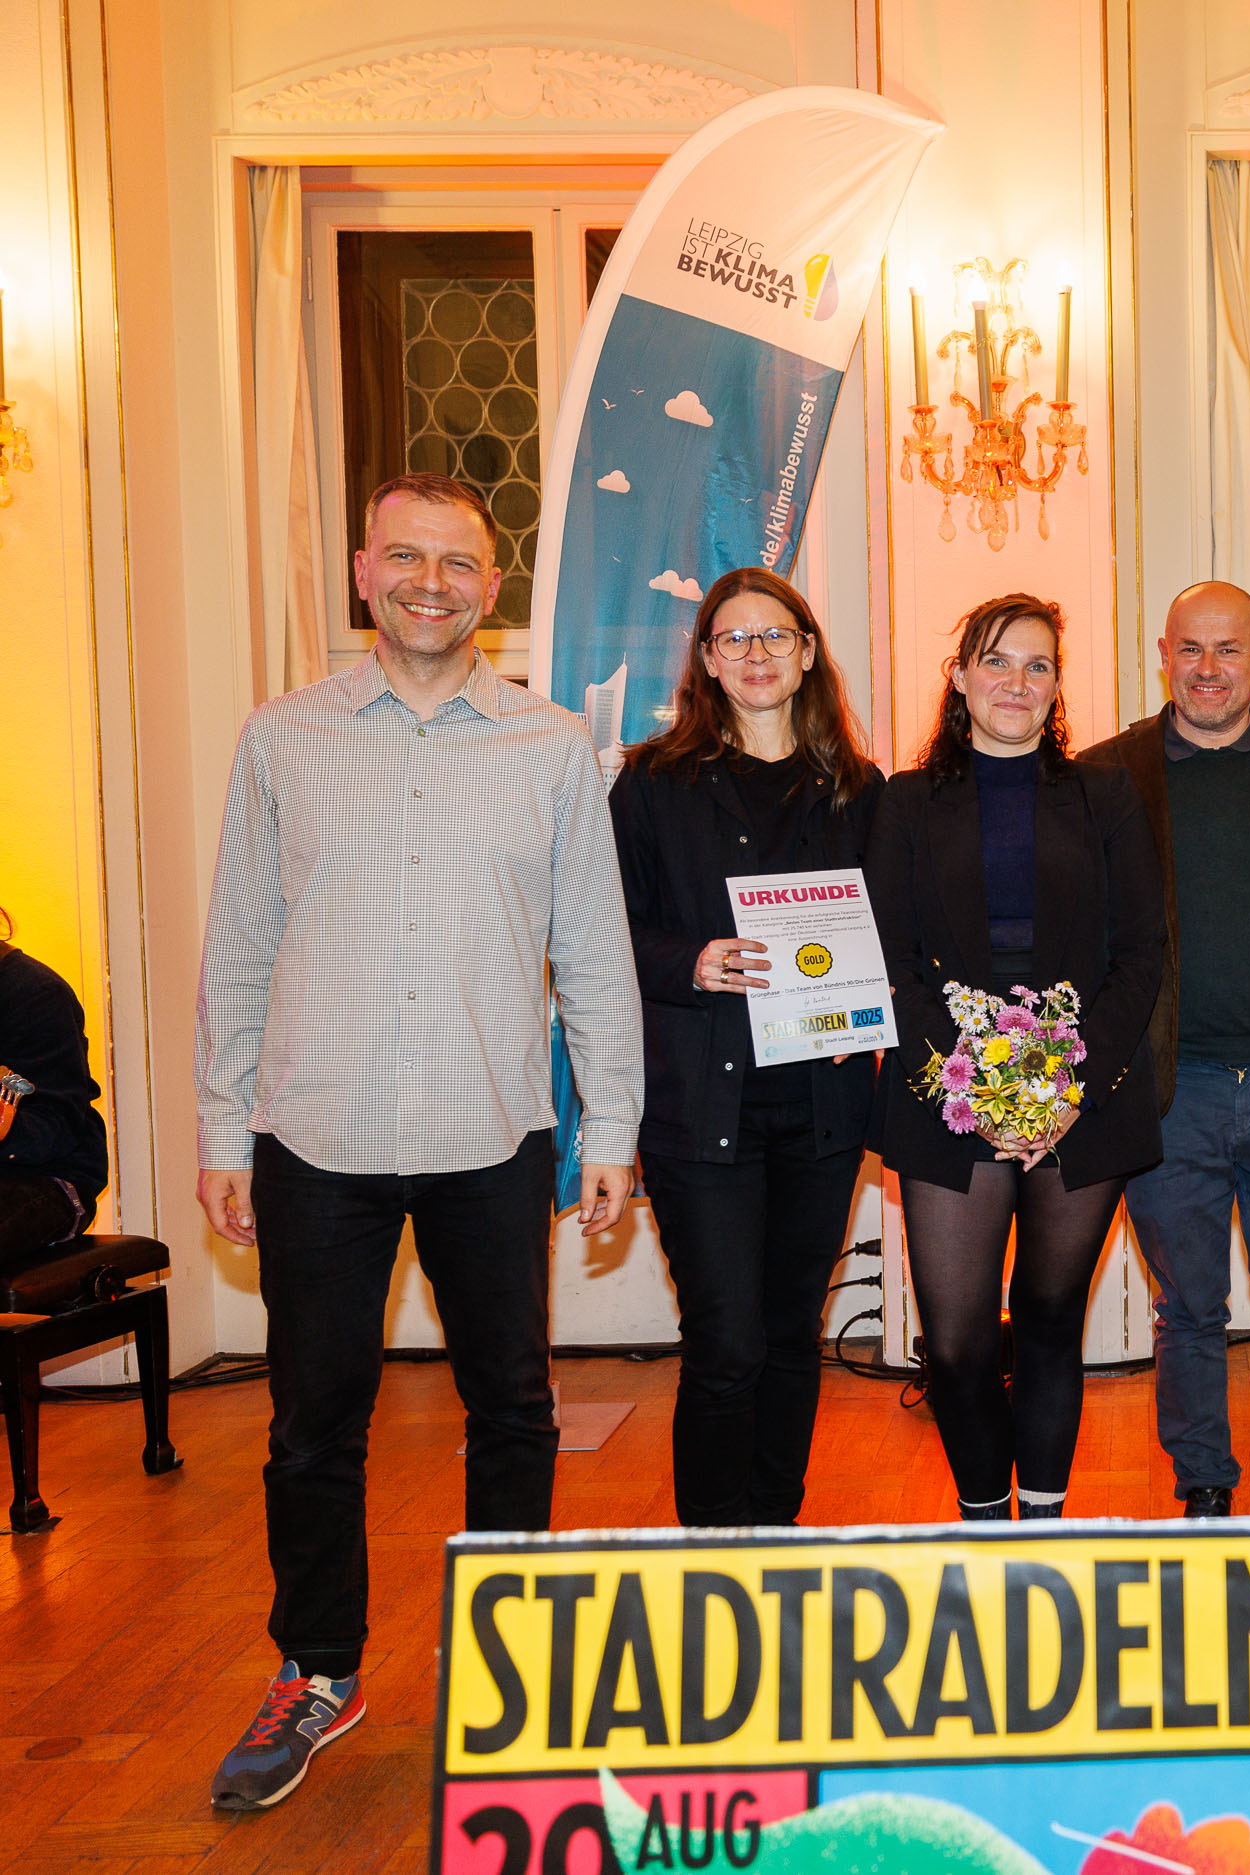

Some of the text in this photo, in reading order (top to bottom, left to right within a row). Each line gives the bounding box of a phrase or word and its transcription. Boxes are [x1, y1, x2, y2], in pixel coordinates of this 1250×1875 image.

[687, 217, 765, 260] LEIPZIG
[677, 253, 797, 309] BEWUSST
[682, 234, 796, 293] IST KLIMA
[738, 884, 861, 907] URKUNDE
[804, 954, 825, 966] GOLD
[763, 1012, 847, 1040] STADTRADELN
[854, 1008, 882, 1027] 2025
[635, 1789, 761, 1870] AUG
